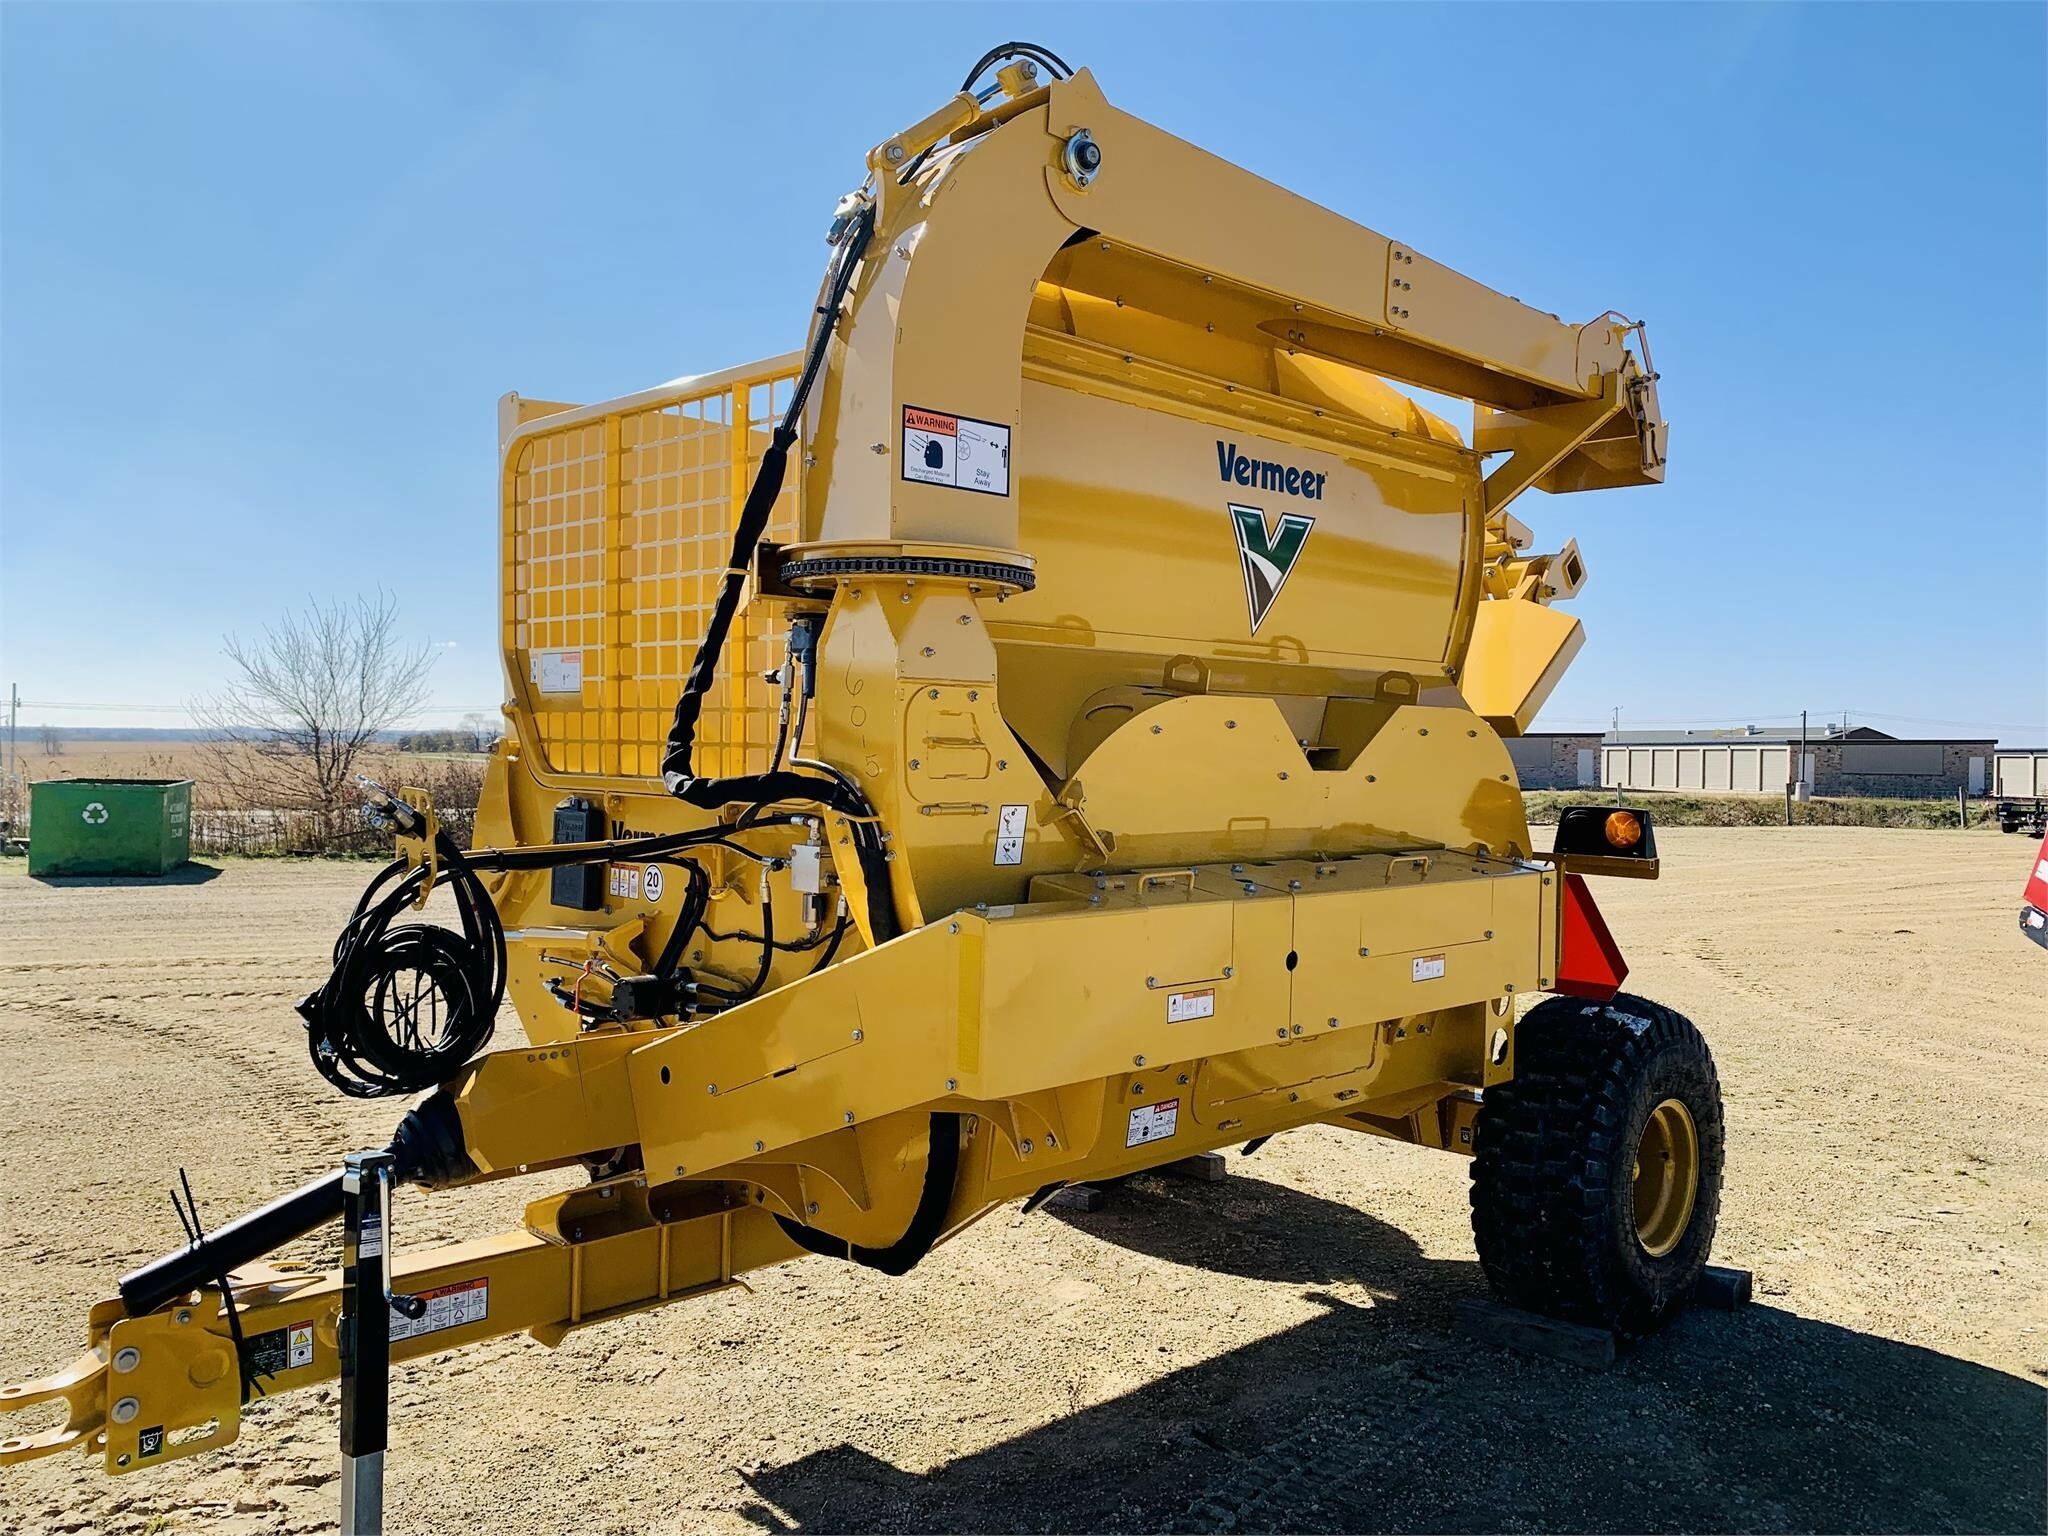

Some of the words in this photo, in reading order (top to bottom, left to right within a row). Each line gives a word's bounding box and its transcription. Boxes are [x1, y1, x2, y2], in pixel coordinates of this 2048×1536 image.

[916, 414, 955, 431] WARNING
[976, 467, 991, 479] Stay
[1216, 440, 1328, 500] Vermeer
[974, 477, 991, 488] Away
[646, 871, 659, 888] 20
[439, 1282, 475, 1298] WARNING
